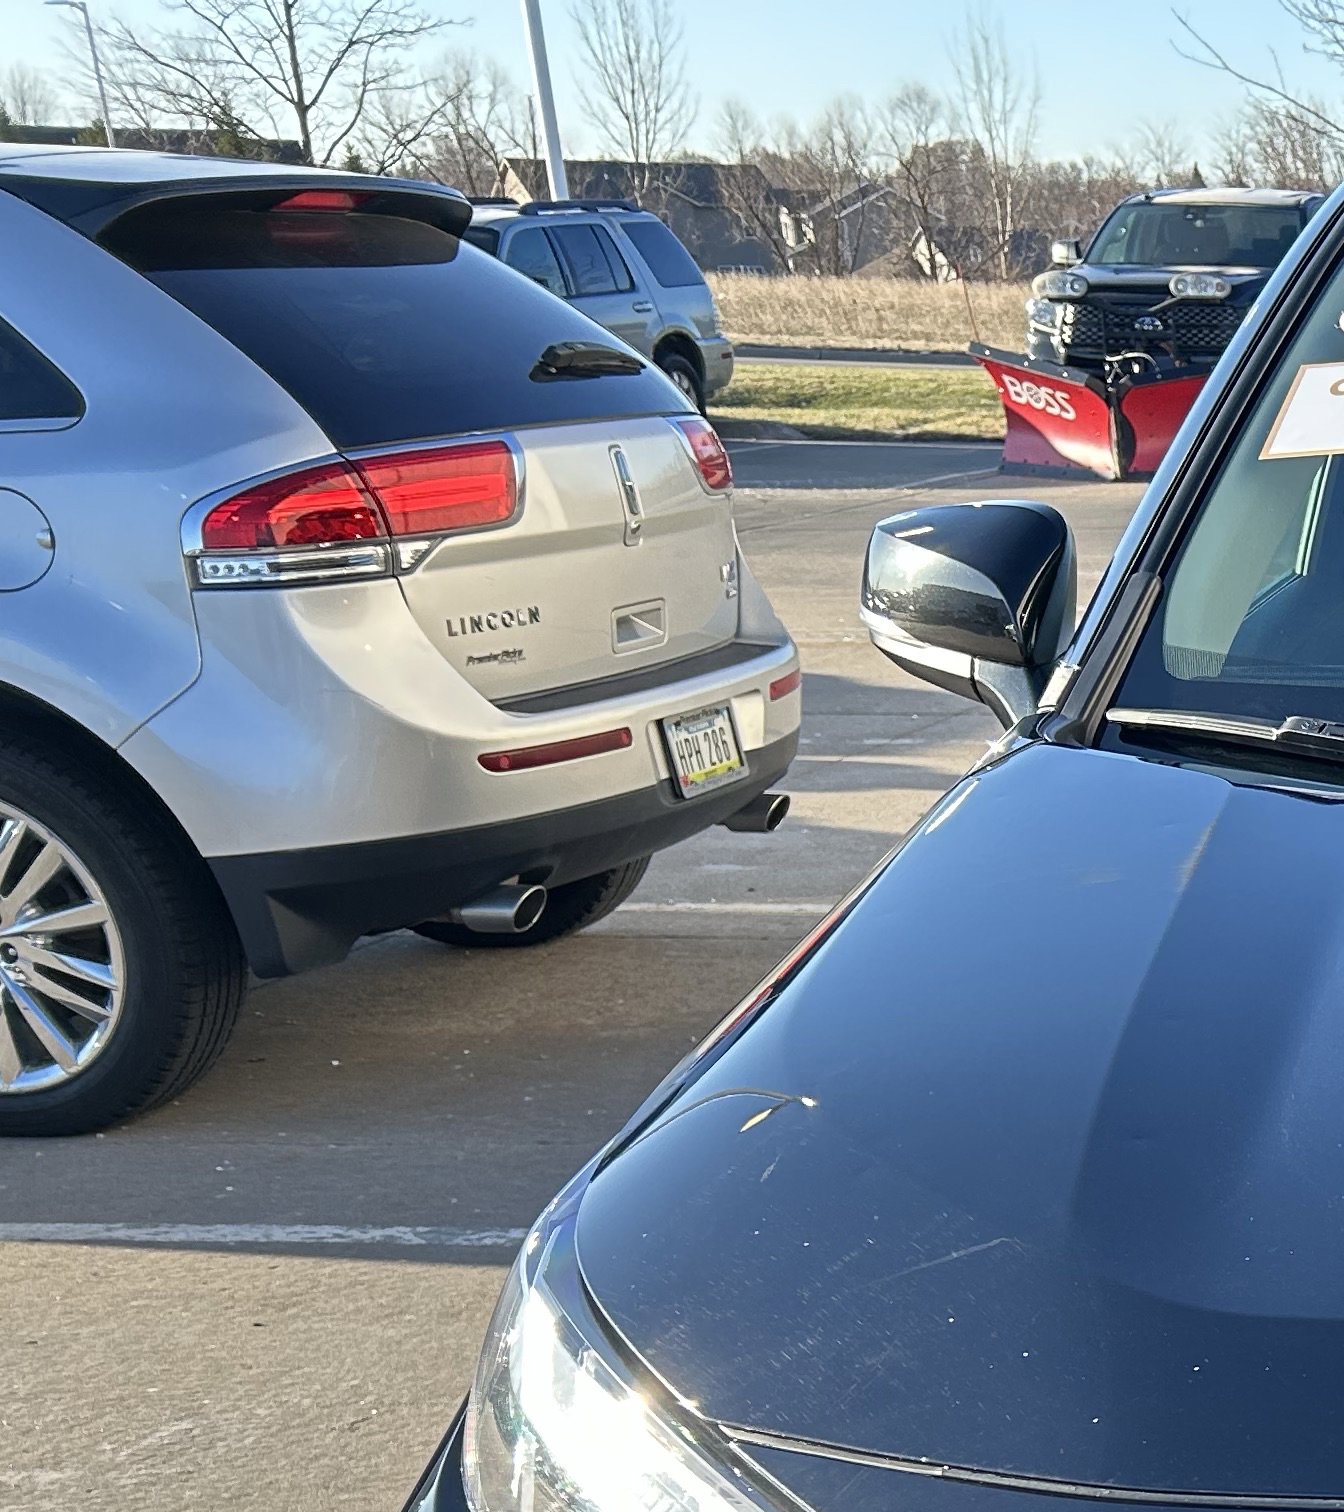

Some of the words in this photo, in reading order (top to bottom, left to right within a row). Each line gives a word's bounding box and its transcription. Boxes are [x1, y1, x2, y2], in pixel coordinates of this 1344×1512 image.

[1001, 374, 1077, 421] BOSS
[445, 605, 541, 637] LINCOLN
[675, 735, 706, 776] HPH
[703, 726, 731, 766] 286
